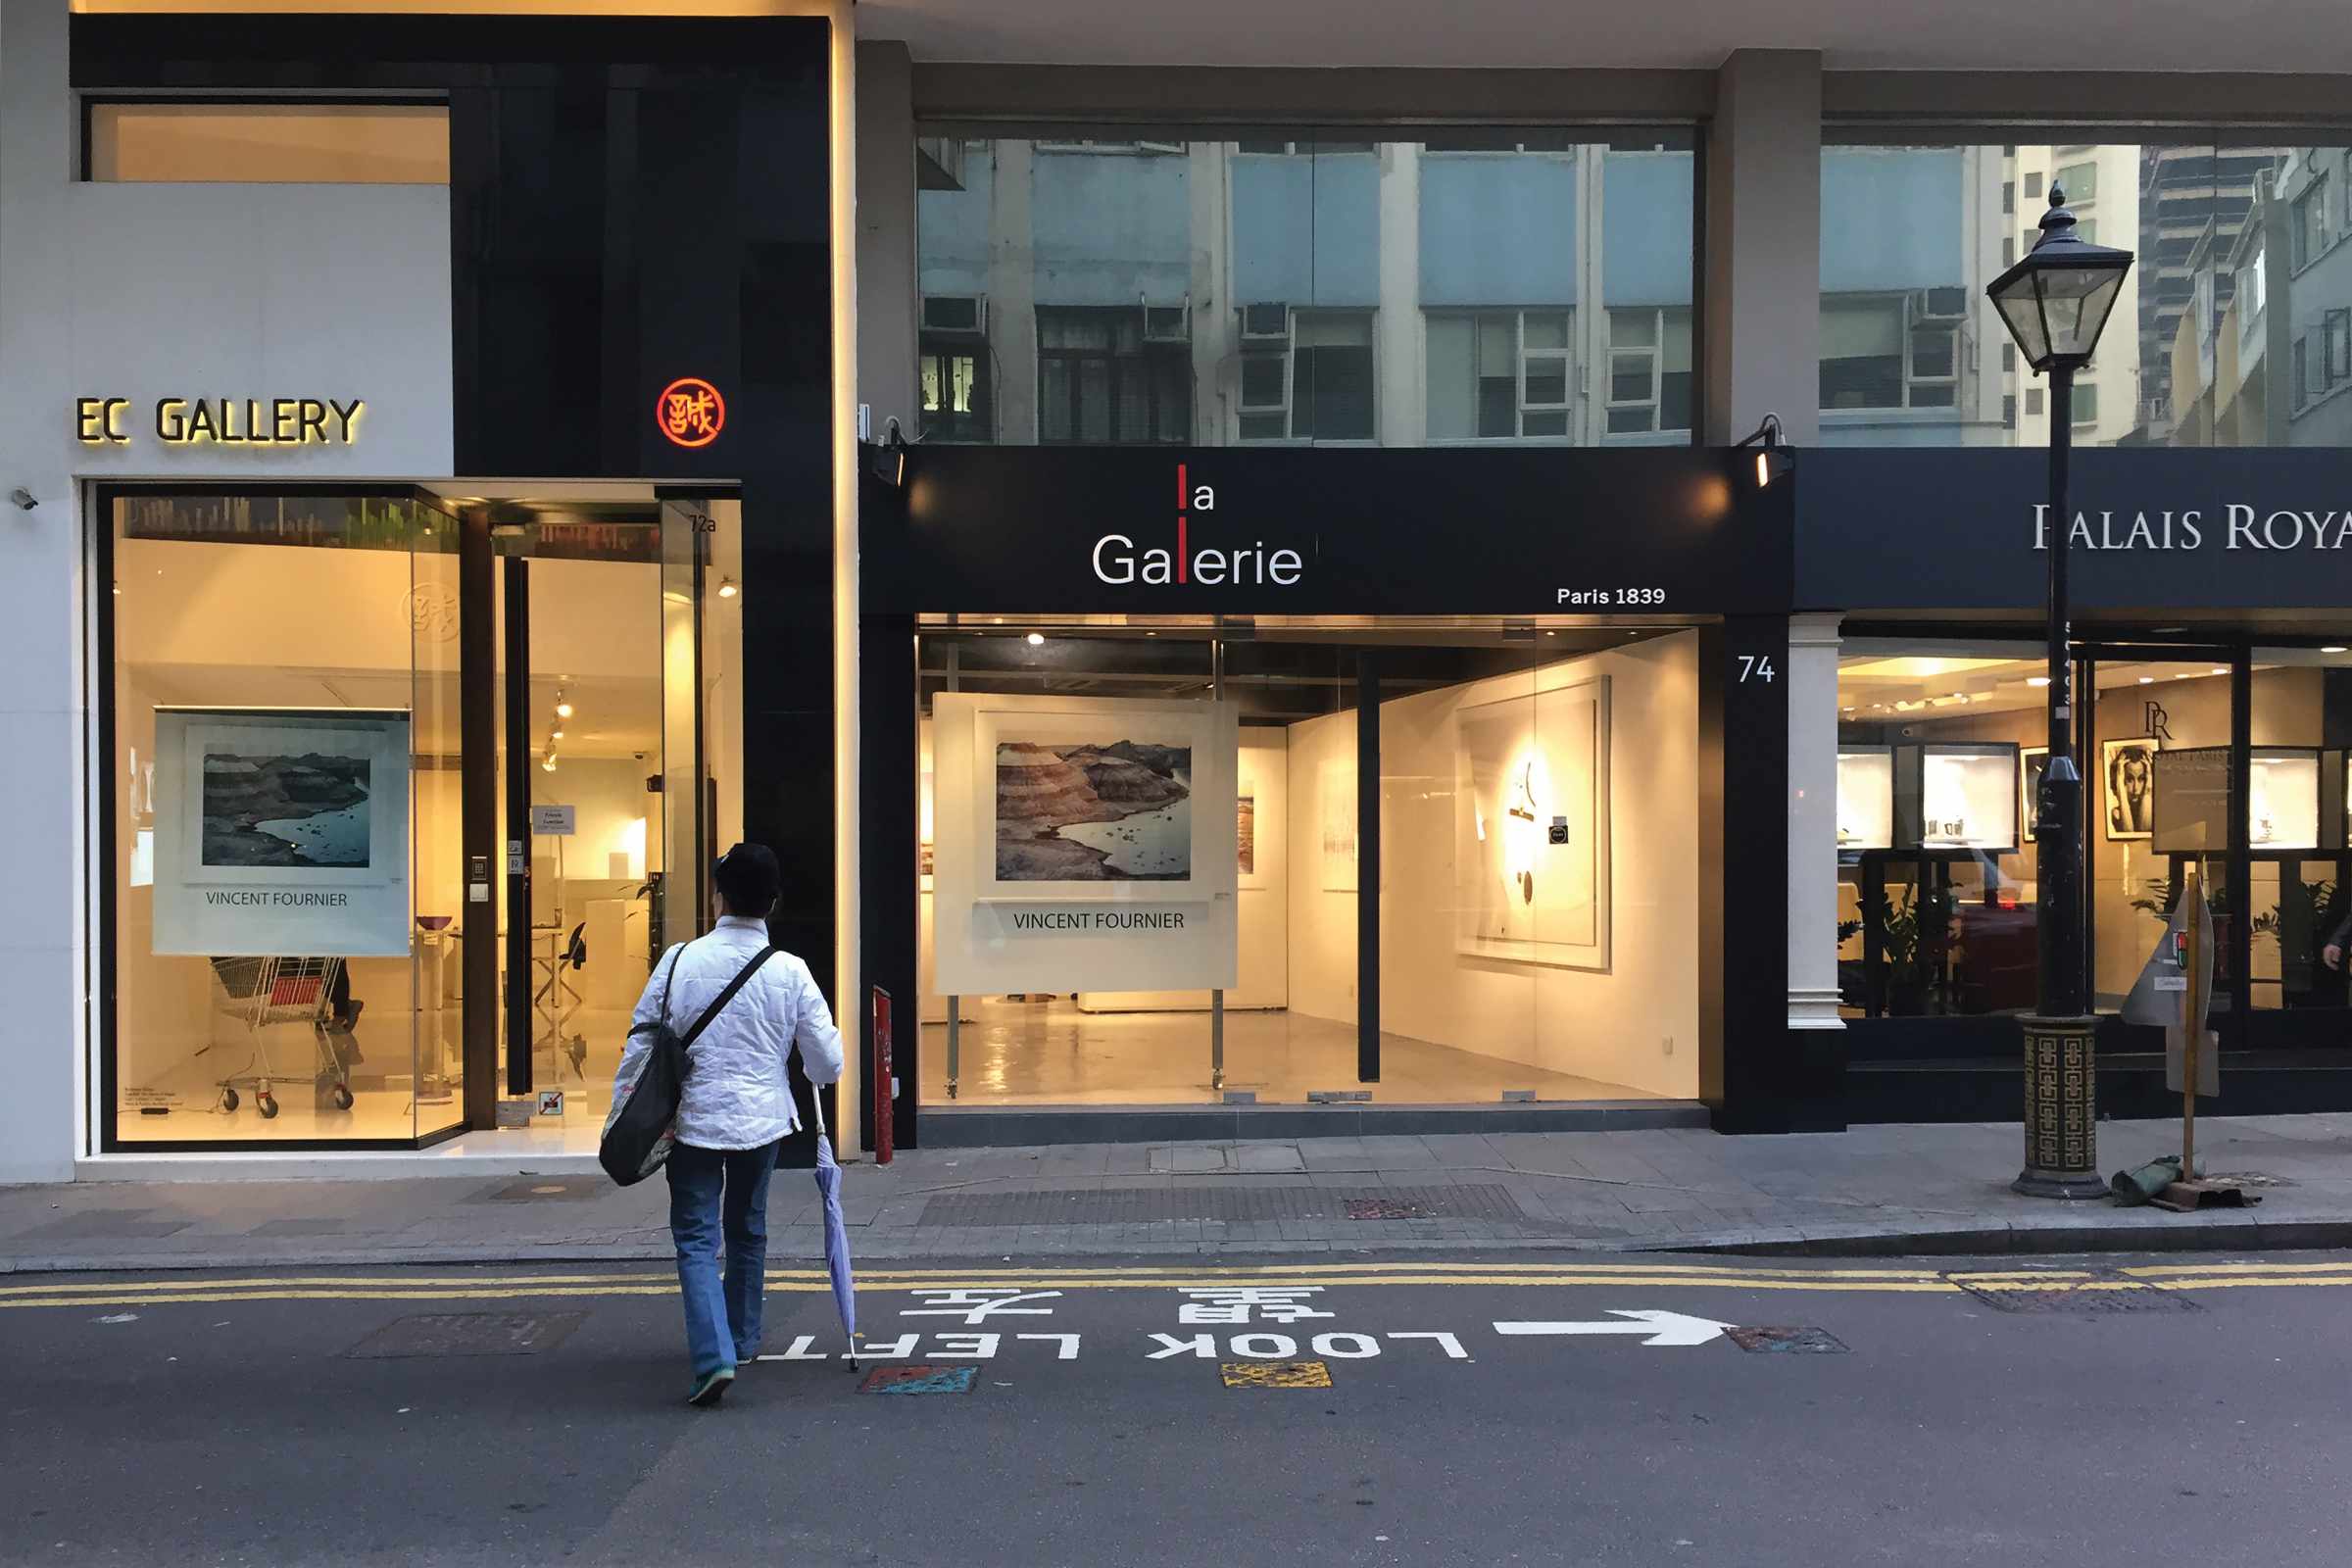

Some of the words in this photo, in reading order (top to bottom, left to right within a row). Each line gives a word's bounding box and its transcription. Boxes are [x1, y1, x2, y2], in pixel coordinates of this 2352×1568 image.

[76, 397, 130, 443] EC
[156, 397, 365, 444] GALLERY
[1178, 463, 1215, 511] la
[689, 514, 716, 533] 72a
[1092, 516, 1303, 585] Galerie
[1557, 588, 1610, 605] Paris
[1616, 588, 1667, 605] 1839
[1737, 655, 1776, 683] 74
[206, 892, 270, 906] VINCENT
[273, 893, 347, 906] FOURNIER
[1013, 912, 1090, 929] VINCENT
[1096, 912, 1185, 929] FOURNIER
[757, 1333, 1081, 1361] LEFT
[1145, 1332, 1469, 1359] LOOK
